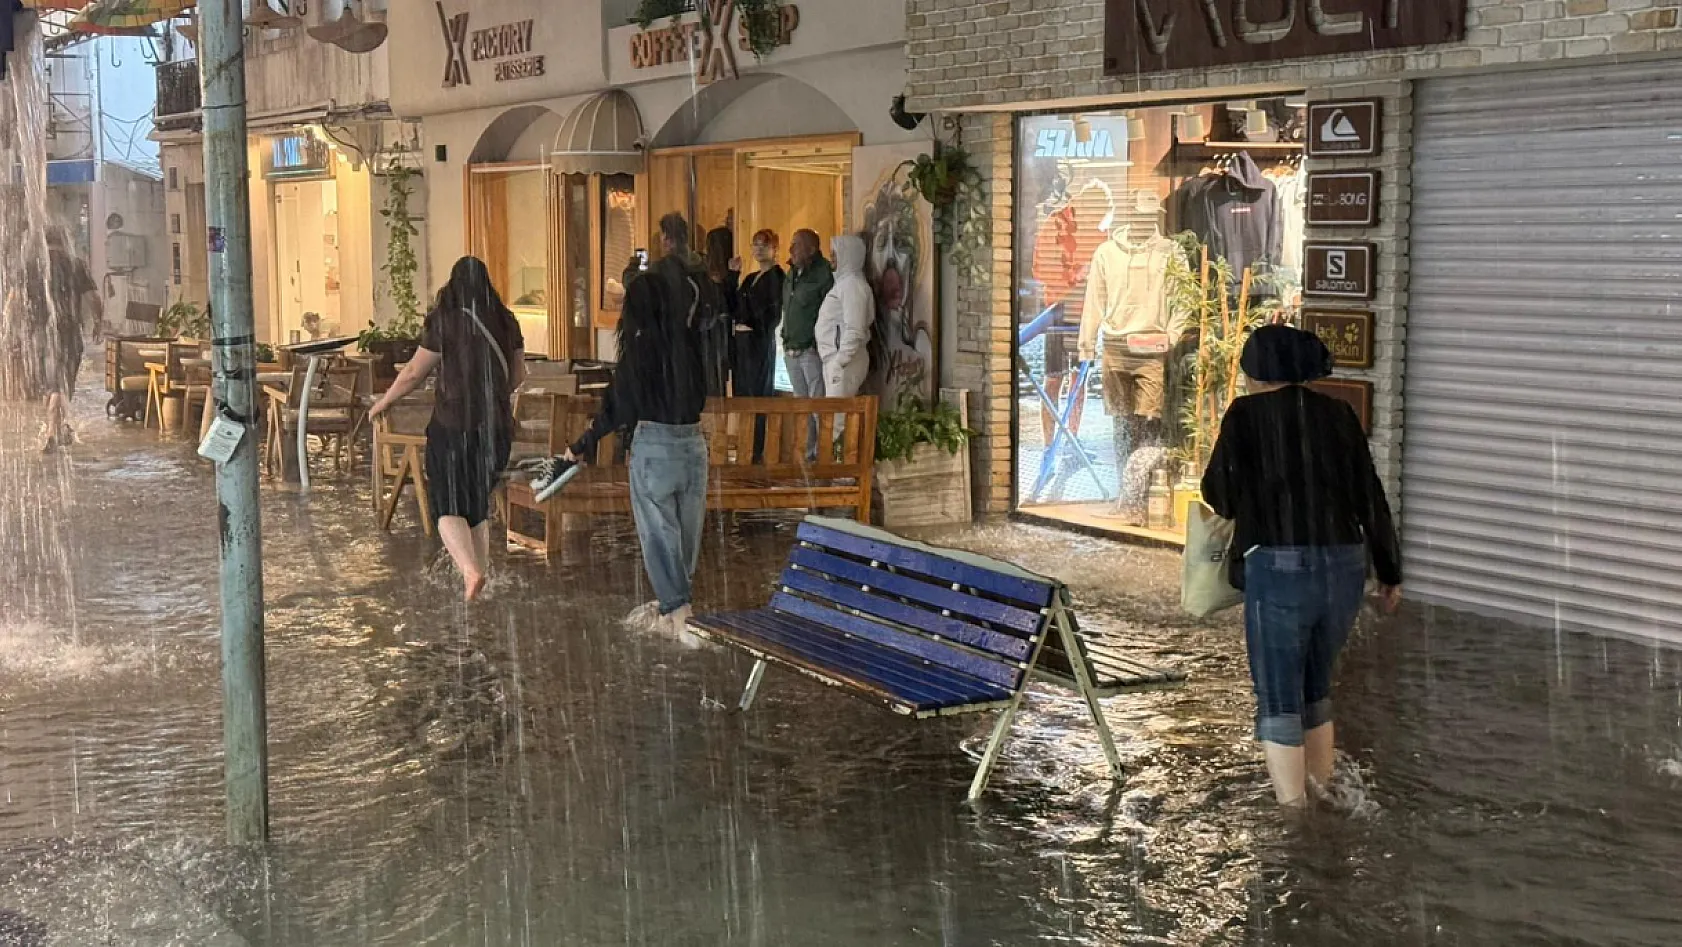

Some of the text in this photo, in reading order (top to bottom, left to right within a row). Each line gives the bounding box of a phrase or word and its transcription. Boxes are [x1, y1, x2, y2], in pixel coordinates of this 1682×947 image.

[471, 19, 533, 61] FACTORY
[630, 22, 701, 69] COFFEE
[738, 3, 799, 51] SP
